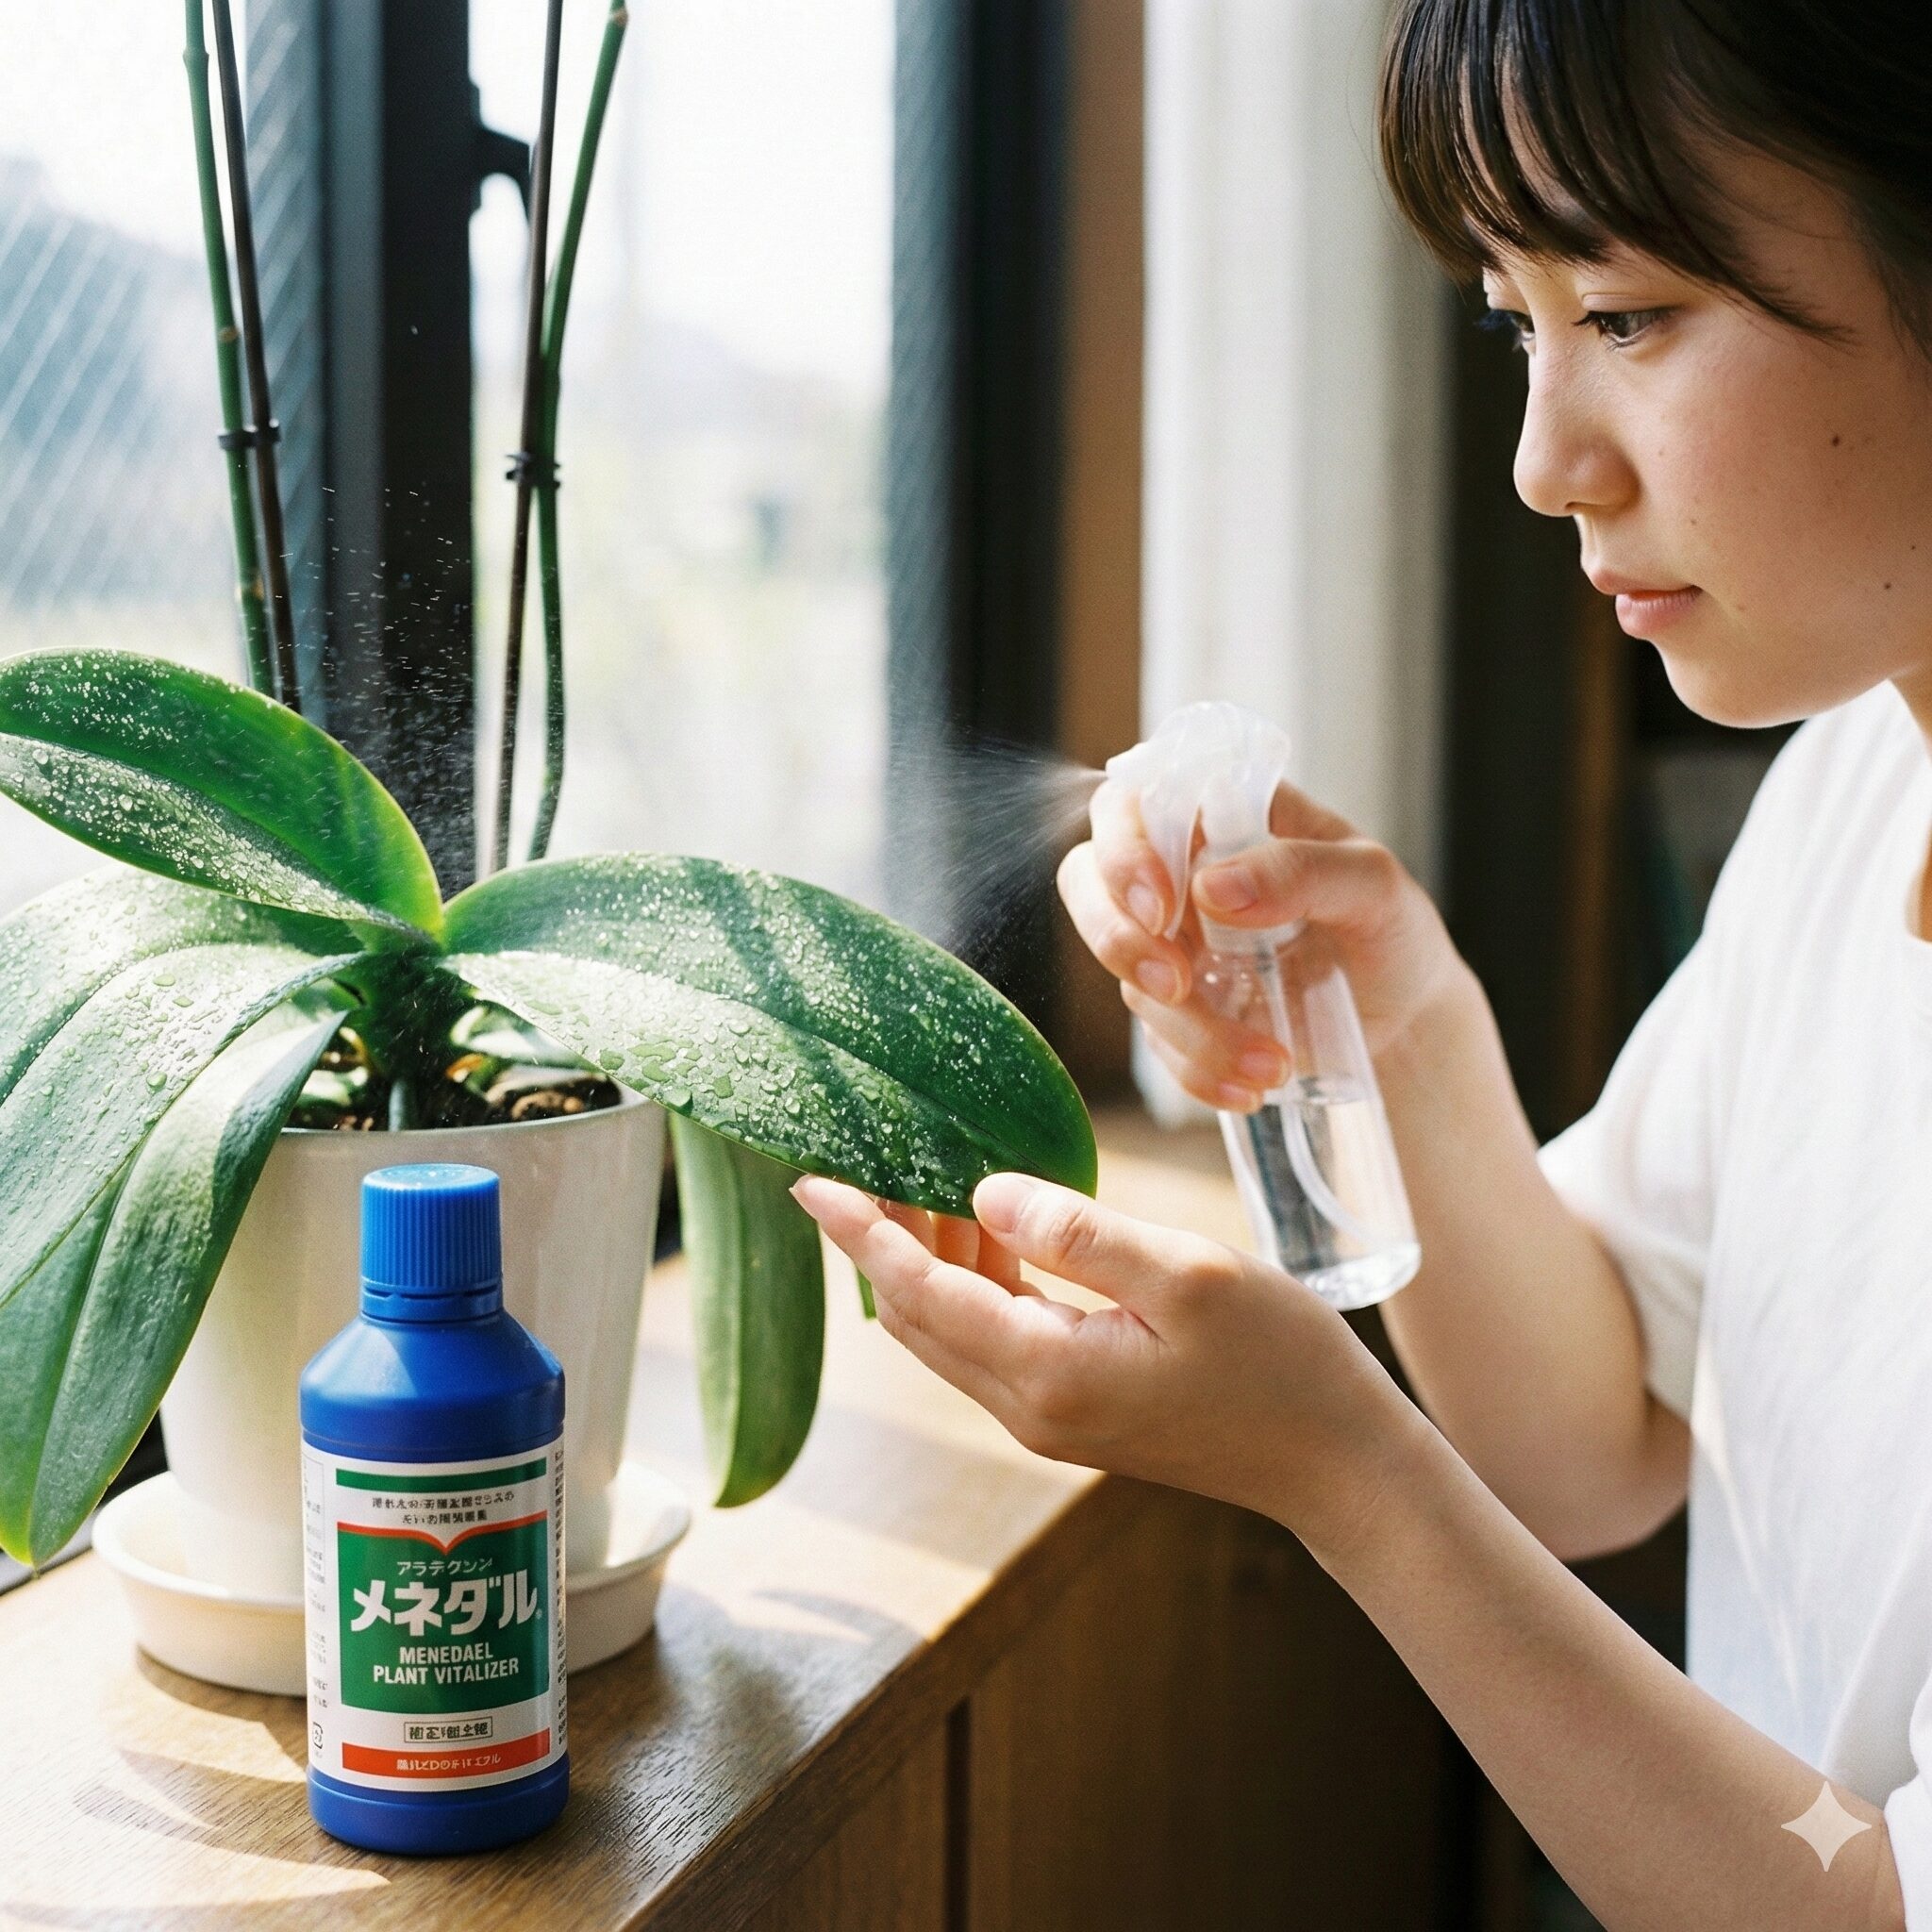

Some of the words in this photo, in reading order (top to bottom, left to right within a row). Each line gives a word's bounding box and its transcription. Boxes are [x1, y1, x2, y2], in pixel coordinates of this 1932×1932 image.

[351, 1569, 538, 1636] メネダル
[399, 1642, 493, 1664] MENEDAEL
[374, 1665, 428, 1685] PLANT
[435, 1657, 519, 1685] VITALIZER
